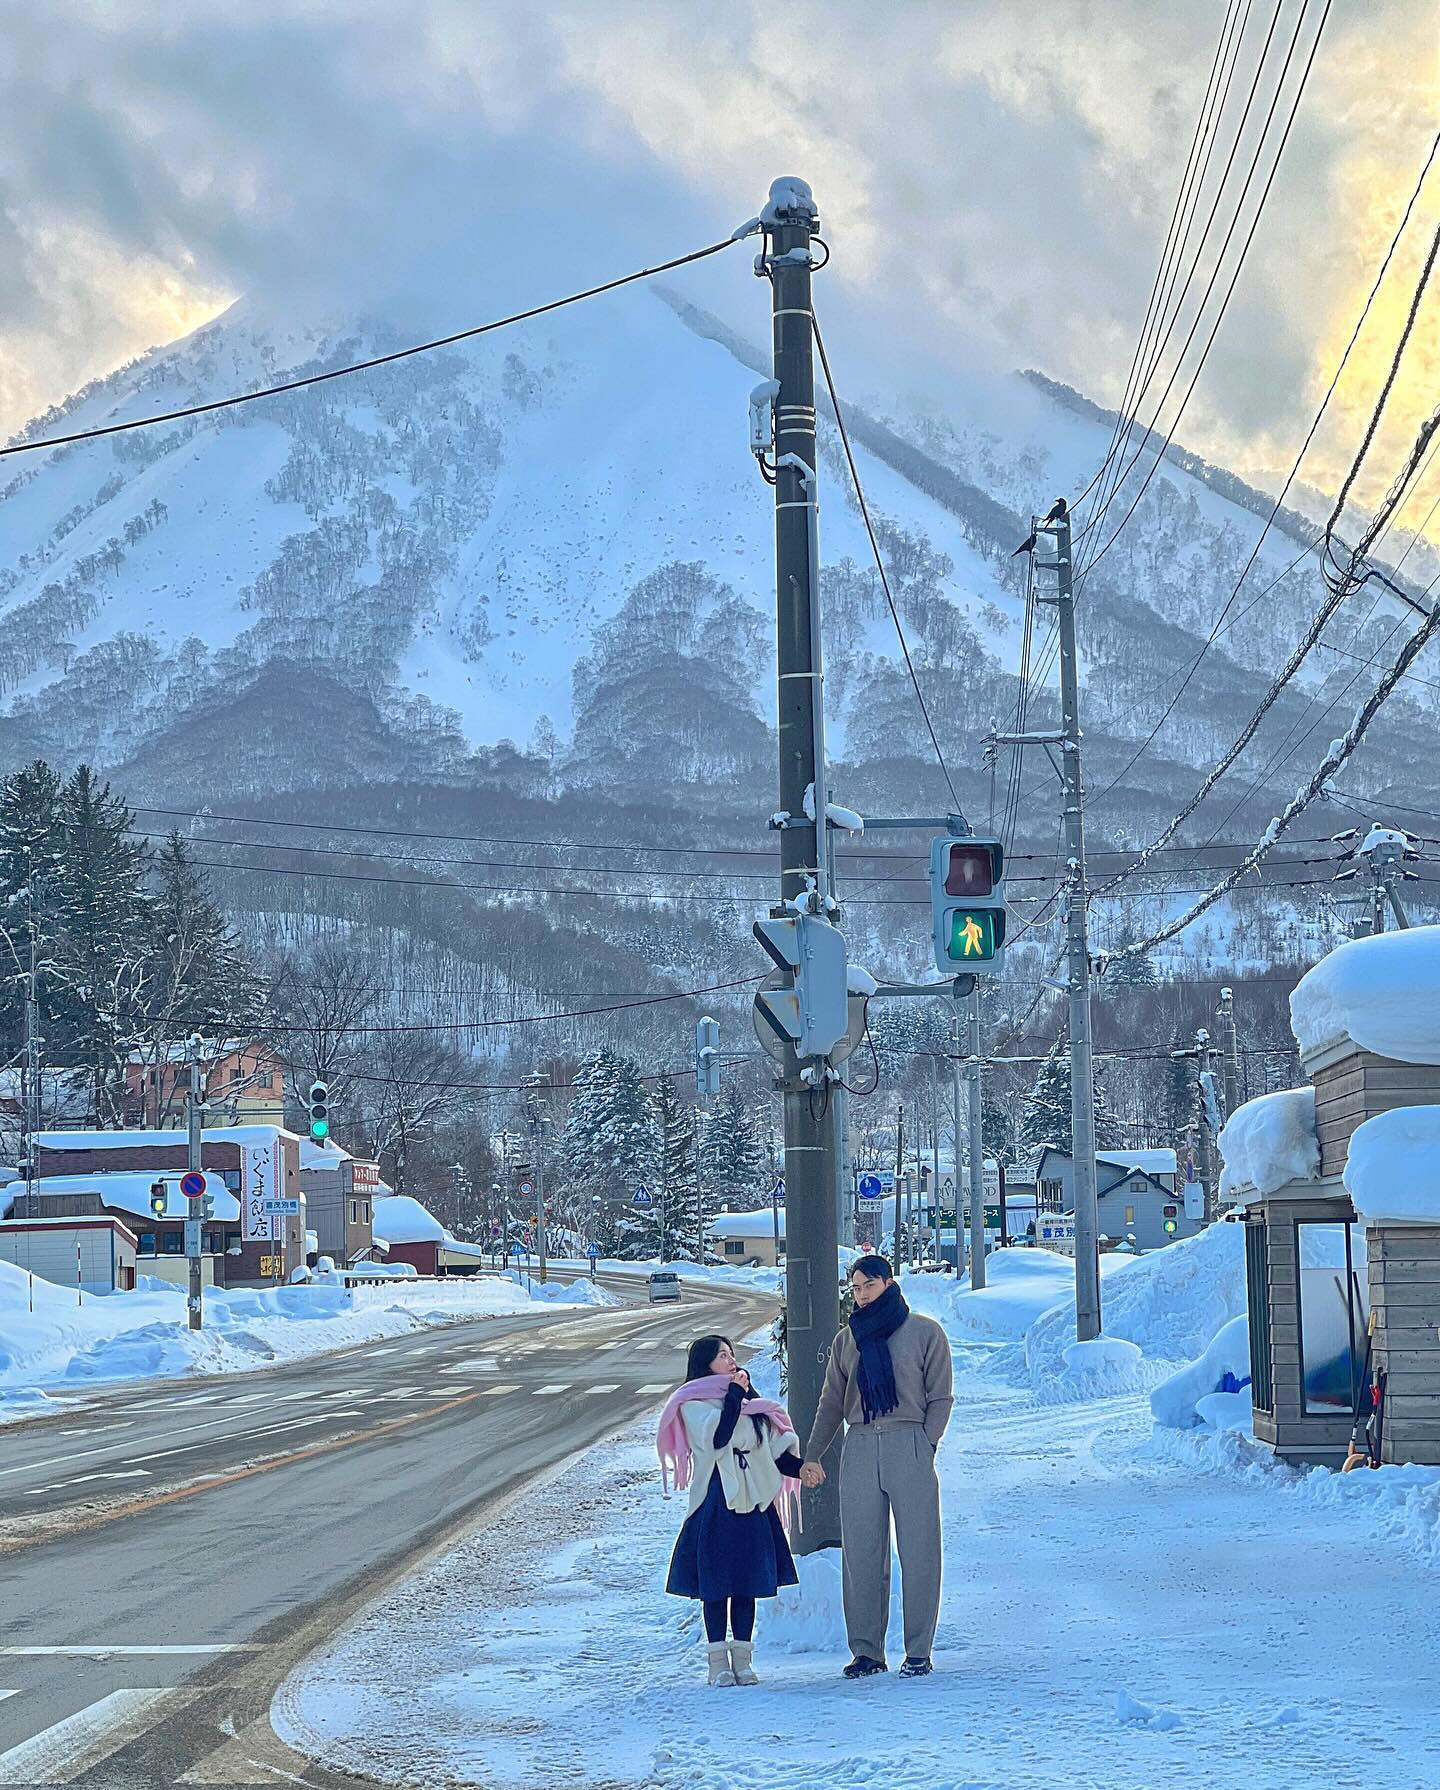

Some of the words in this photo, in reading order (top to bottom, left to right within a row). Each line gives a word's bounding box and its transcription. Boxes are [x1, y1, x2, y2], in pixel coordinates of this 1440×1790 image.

[930, 1209, 999, 1218] リーウゴコース
